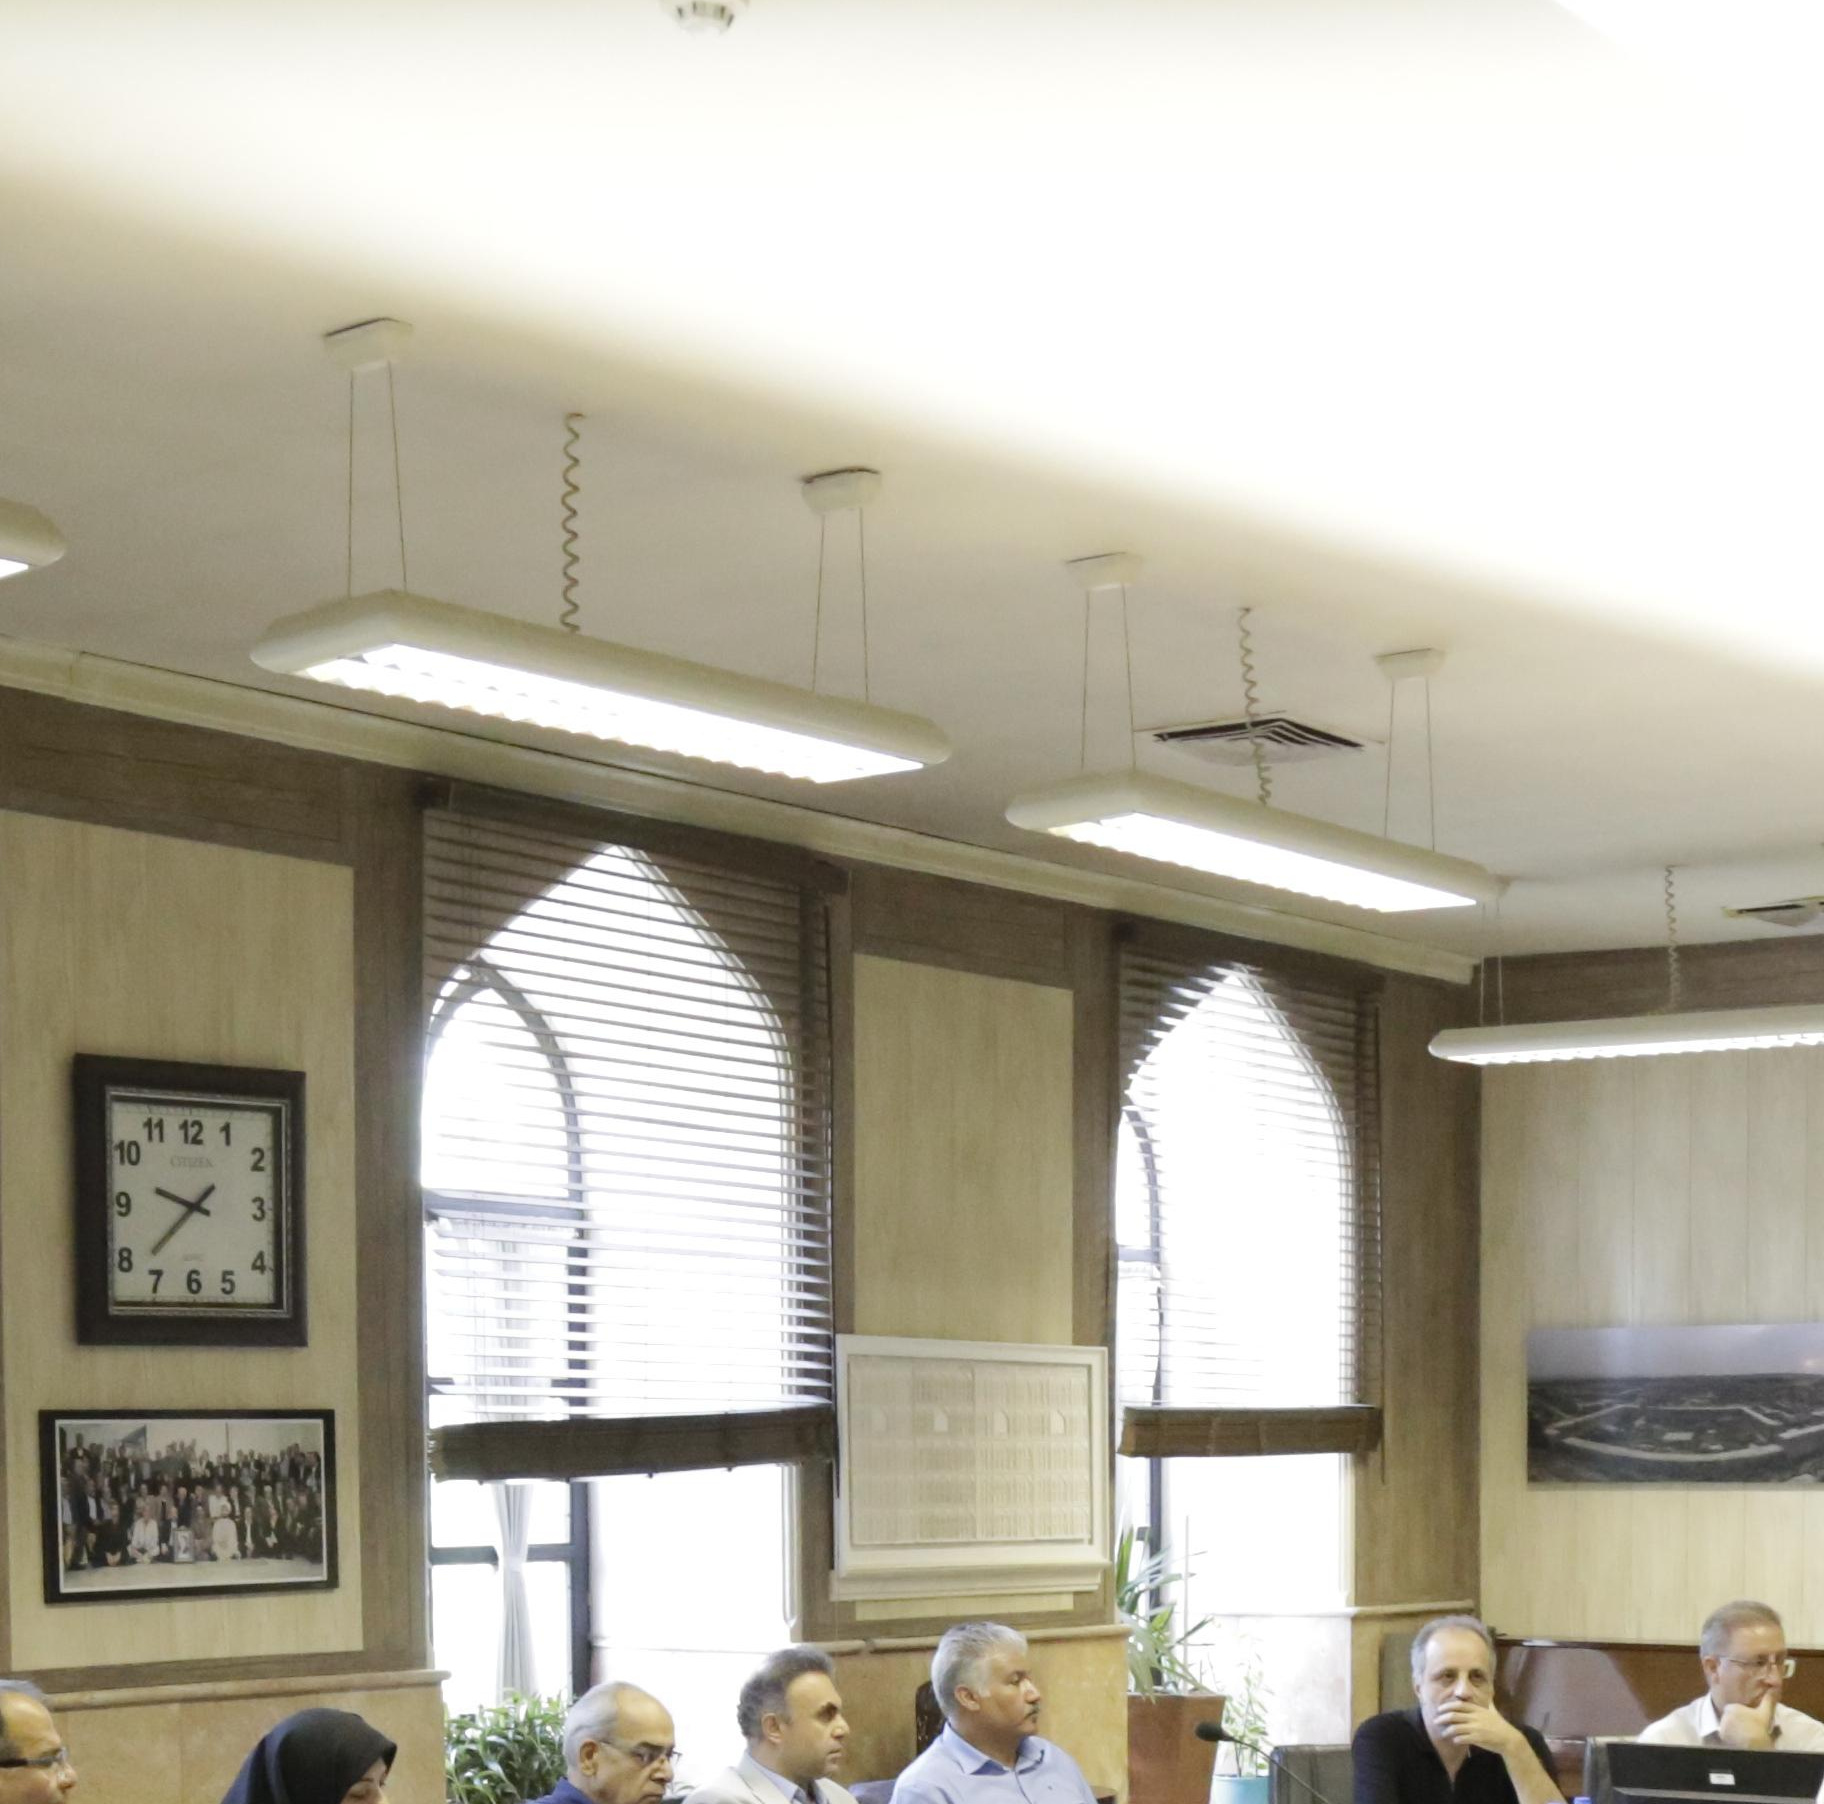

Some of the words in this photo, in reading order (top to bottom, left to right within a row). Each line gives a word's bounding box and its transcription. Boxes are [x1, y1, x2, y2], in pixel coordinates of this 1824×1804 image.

[142, 1117, 164, 1143] 11
[178, 1119, 204, 1145] 12
[219, 1122, 231, 1146] 1
[114, 1140, 141, 1166] 10
[250, 1147, 265, 1172] 2
[115, 1191, 132, 1217] 9
[251, 1197, 265, 1221] 3
[118, 1247, 133, 1273] 8
[251, 1251, 266, 1275] 4
[148, 1269, 163, 1294] 7
[186, 1269, 202, 1295] 6
[220, 1271, 236, 1295] 5
